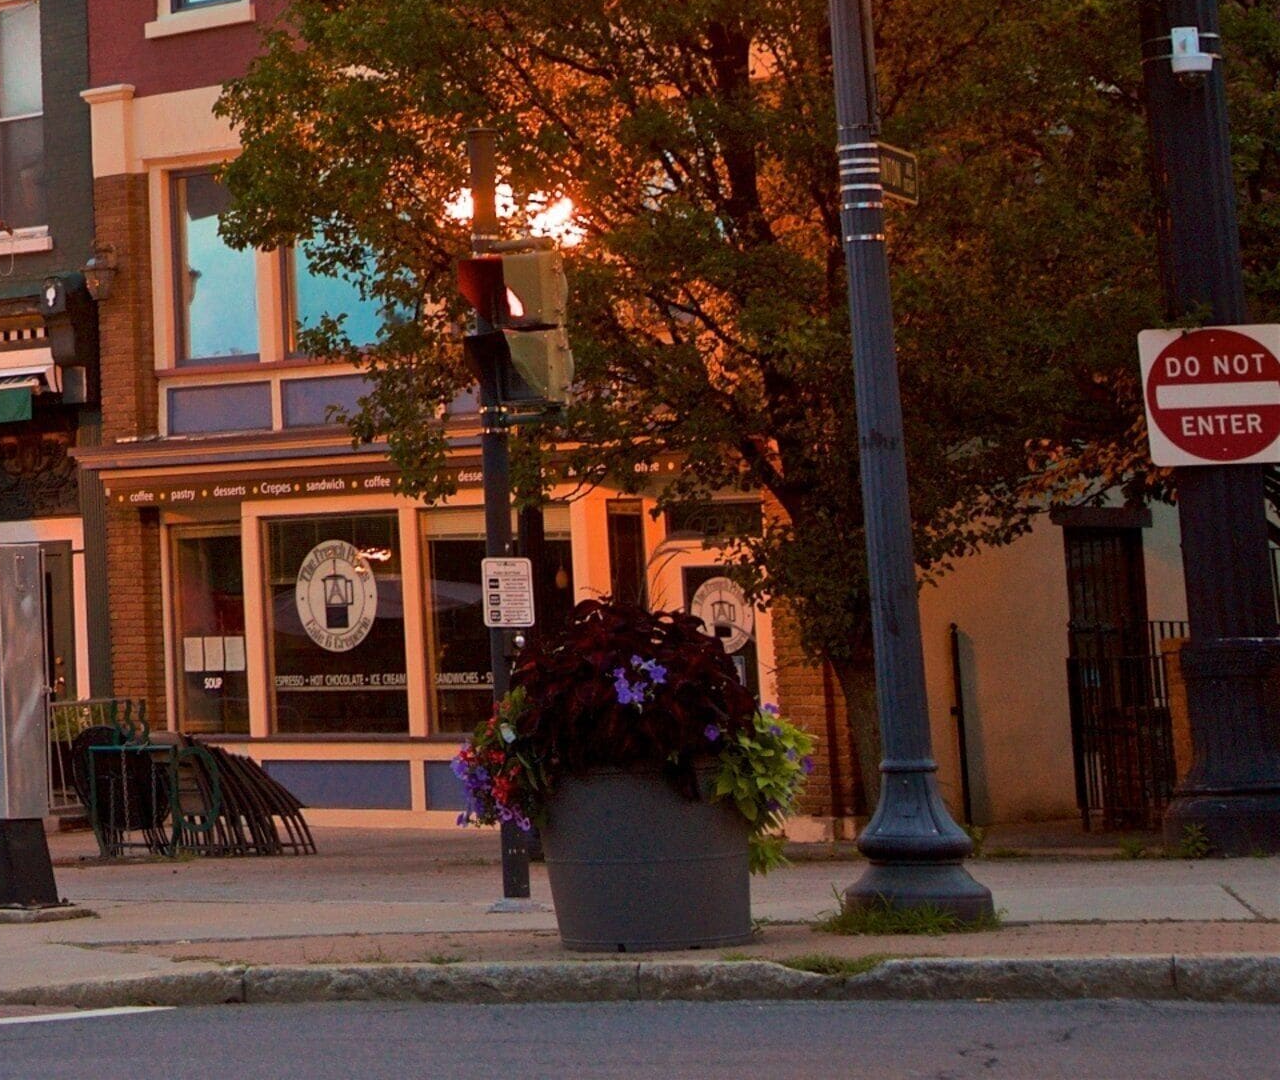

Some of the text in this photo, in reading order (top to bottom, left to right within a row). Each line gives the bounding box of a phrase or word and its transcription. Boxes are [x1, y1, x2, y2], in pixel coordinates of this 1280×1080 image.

[1165, 353, 1265, 378] DO NOT
[1181, 414, 1263, 437] ENTER
[129, 492, 154, 502] coffee
[170, 489, 195, 501] pastry
[213, 485, 246, 497] desserts
[260, 482, 291, 495] Crepes
[306, 478, 345, 491] sandwich
[364, 476, 391, 488] coffee
[458, 470, 483, 482] desse
[204, 677, 223, 689] SOUP
[275, 674, 304, 686] ESPRESSO
[310, 673, 323, 685] HOT
[325, 673, 364, 685] CHOCOLATE
[370, 673, 380, 685] ICE
[383, 672, 406, 684] CREAM
[435, 672, 479, 683] SANDWICHES
